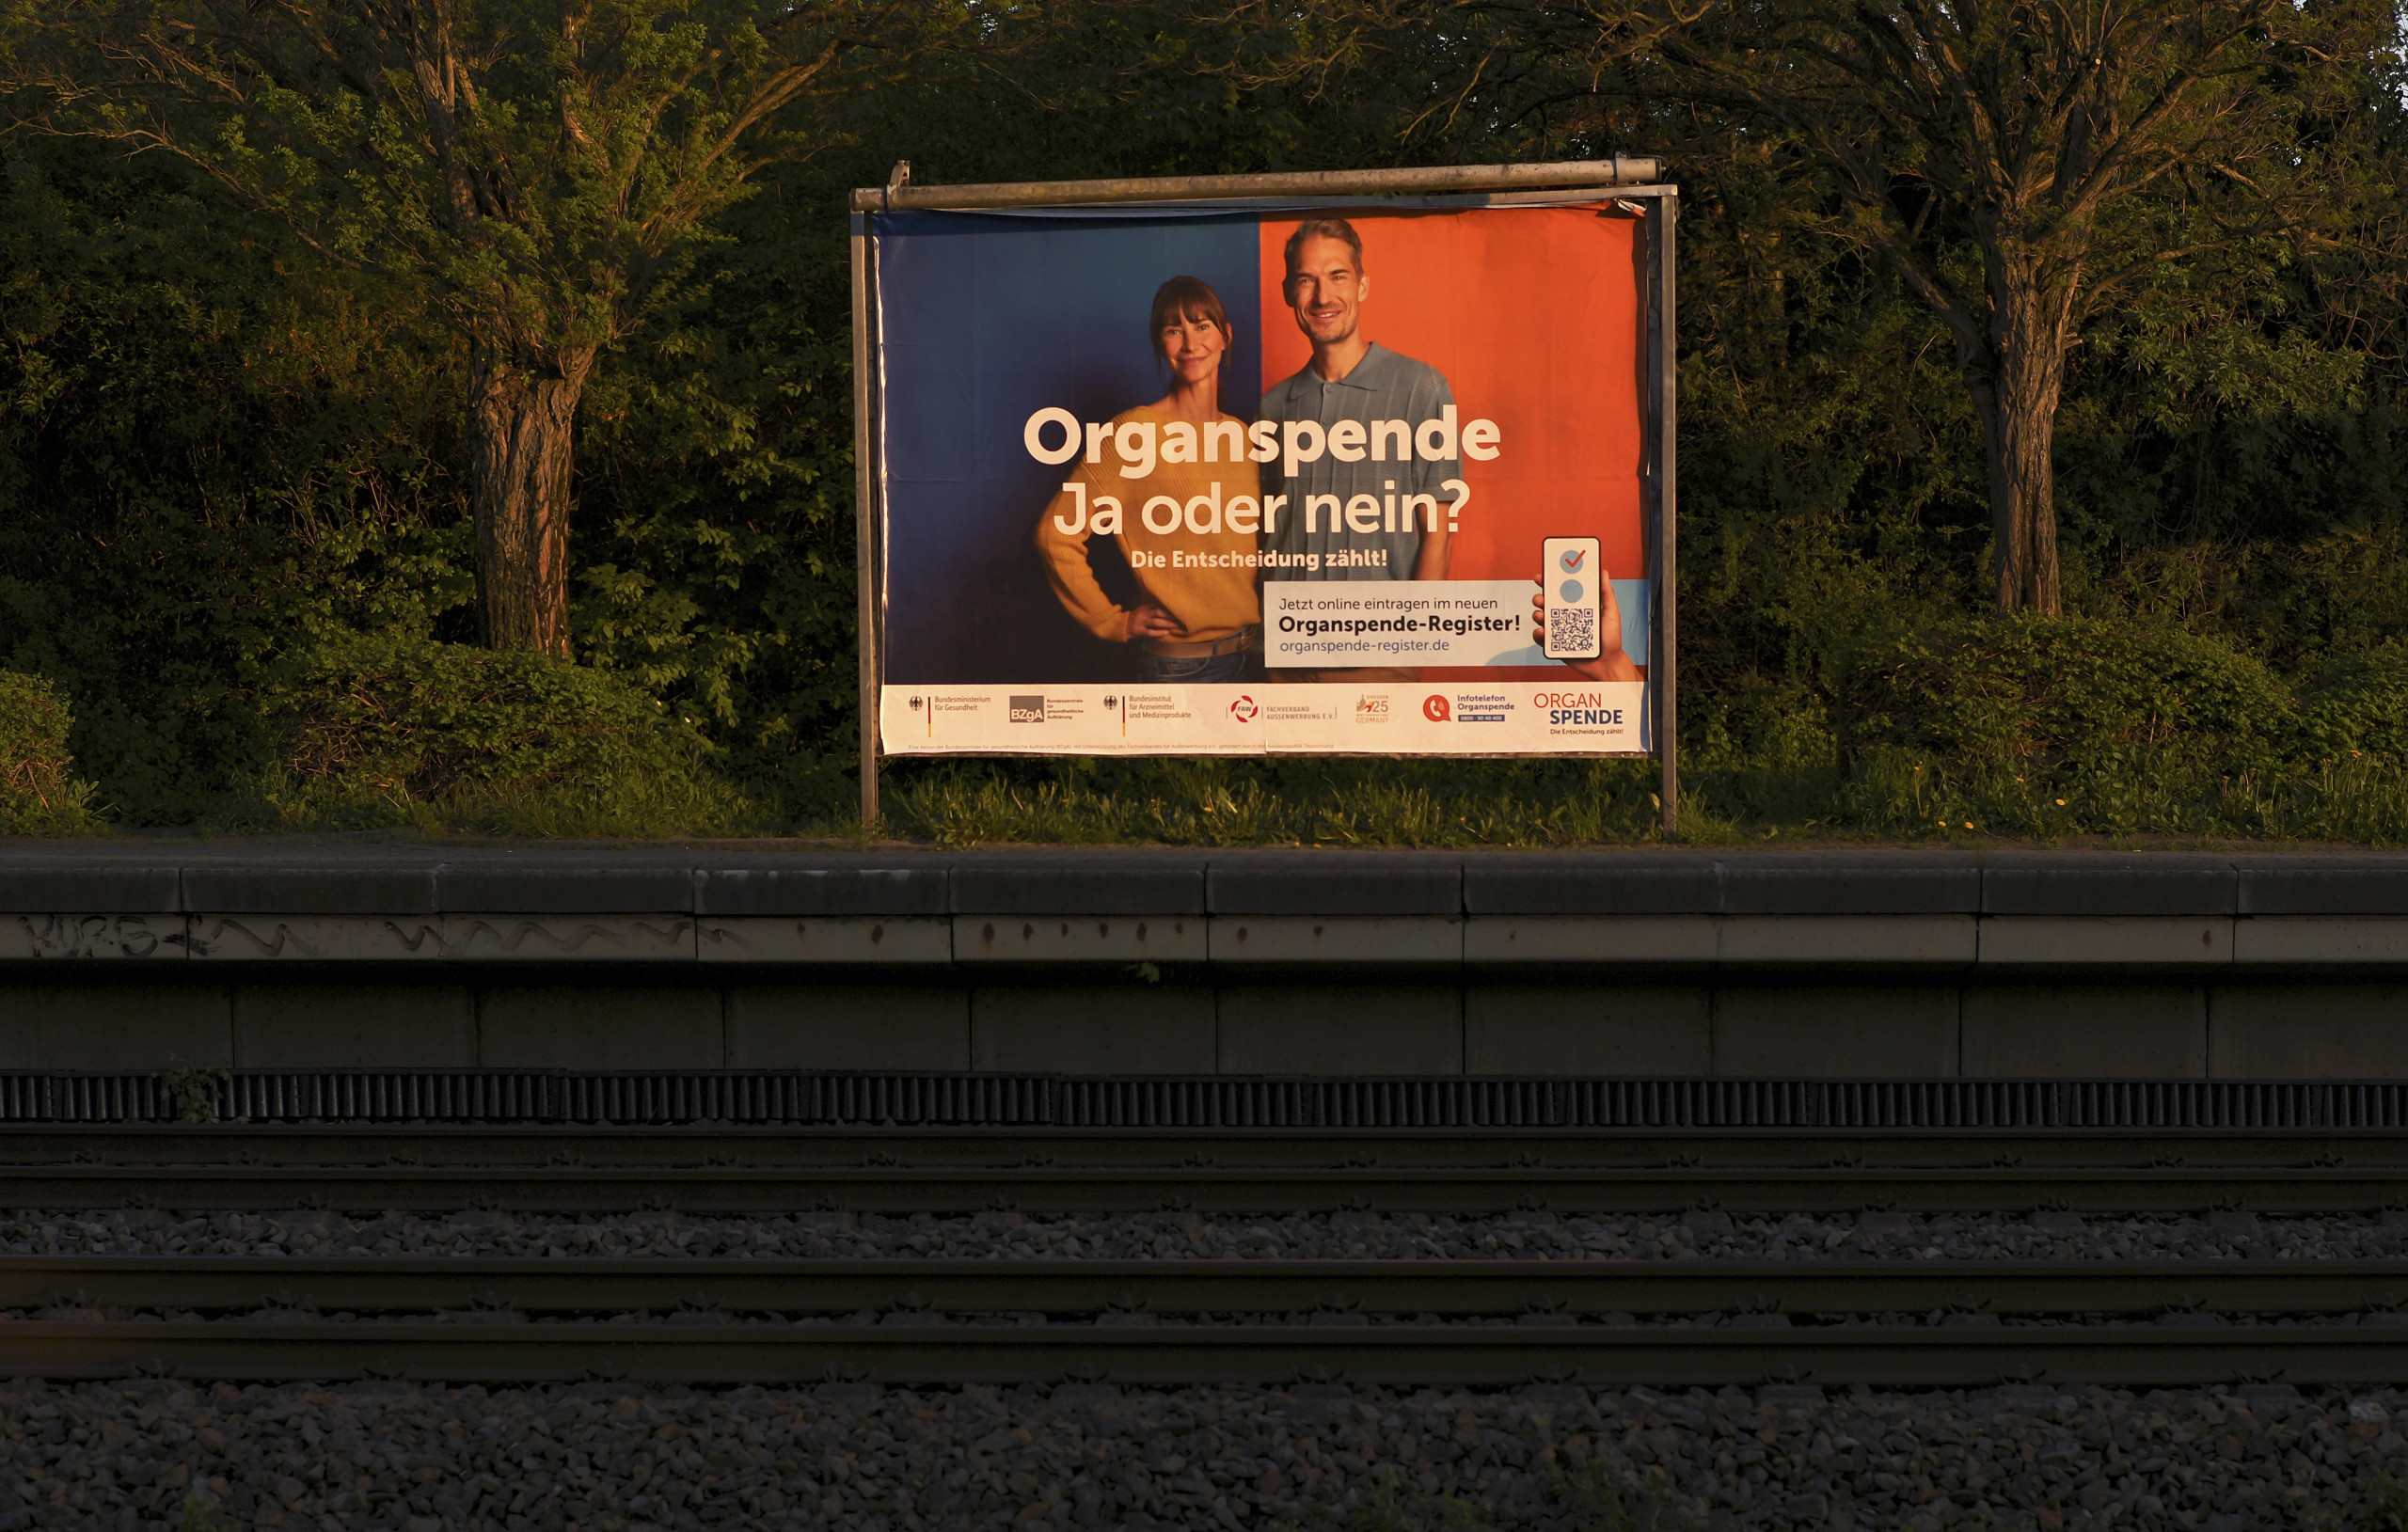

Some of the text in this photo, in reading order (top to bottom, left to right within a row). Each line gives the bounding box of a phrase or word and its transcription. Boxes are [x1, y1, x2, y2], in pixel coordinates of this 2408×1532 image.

[1023, 404, 1501, 479] Organspende
[1054, 479, 1471, 535] Ja oder nein?
[1131, 549, 1387, 572] Die Entscheidung zählt!
[1279, 597, 1498, 612] Jetzt online eintragen im neuen
[1278, 614, 1520, 637] Organspende-Register!
[1279, 640, 1450, 655] organspende-register.de
[1457, 694, 1505, 703] Infotelefon
[1533, 692, 1602, 708] ORGAN
[1142, 711, 1192, 719] Medizinprodukte
[1457, 703, 1515, 712] Organspende
[1010, 709, 1043, 722] BZgA
[1549, 709, 1624, 725] SPENDE
[1561, 728, 1605, 736] Entscheidung
